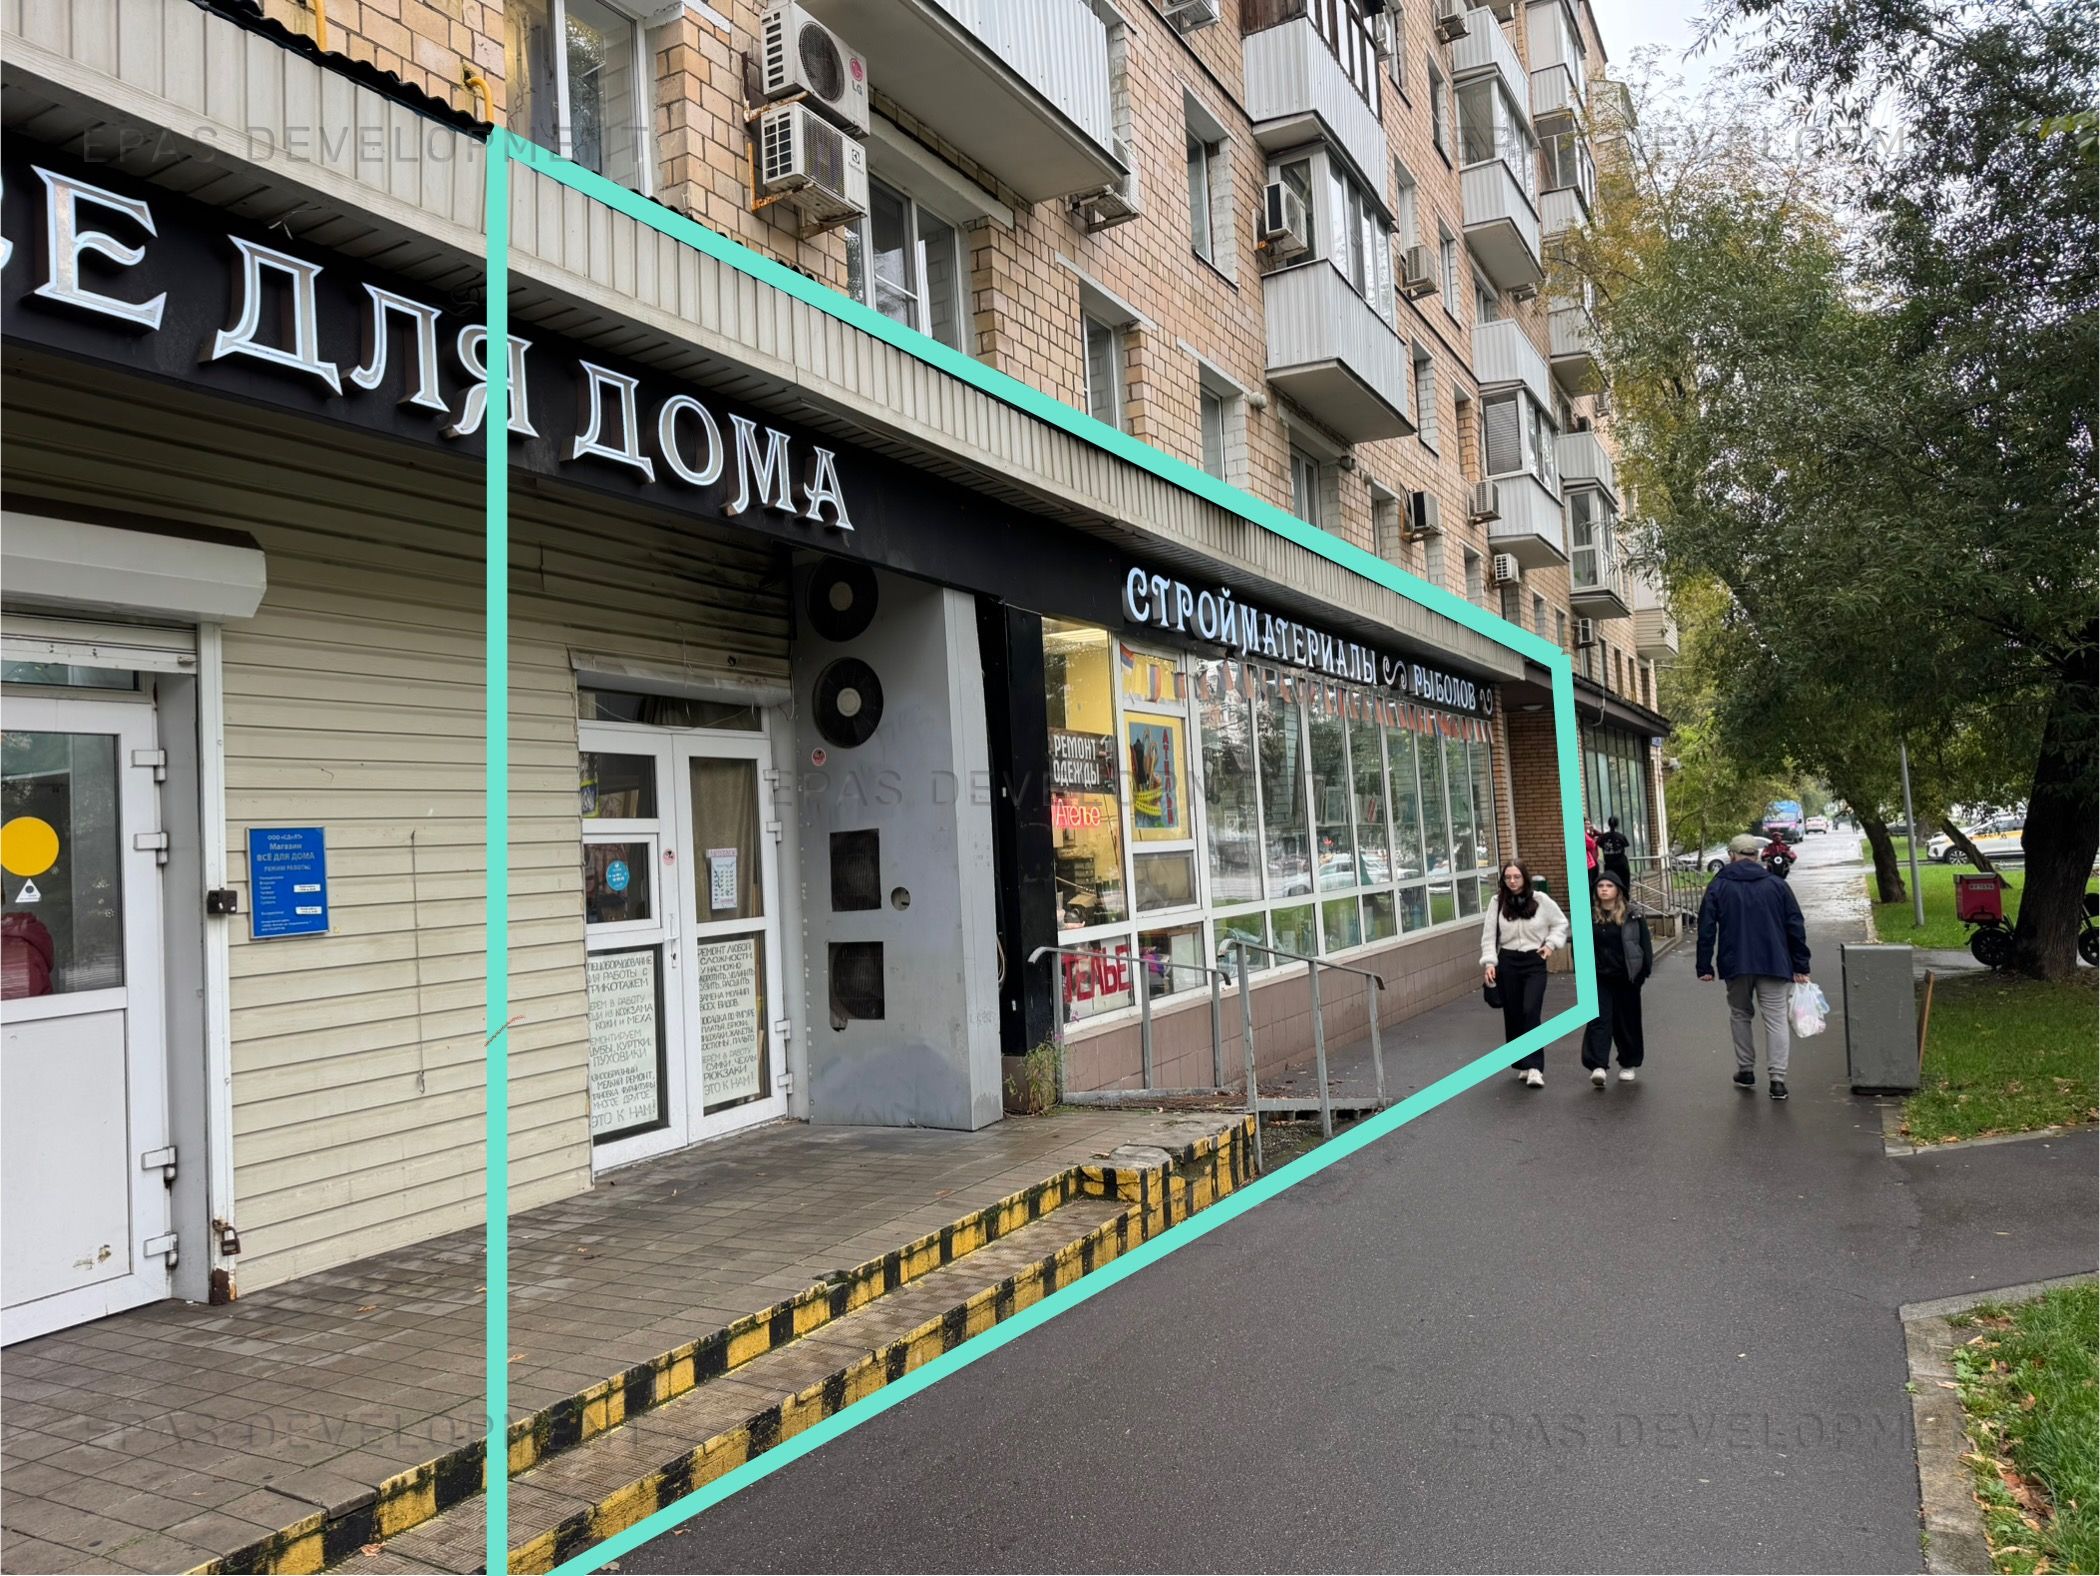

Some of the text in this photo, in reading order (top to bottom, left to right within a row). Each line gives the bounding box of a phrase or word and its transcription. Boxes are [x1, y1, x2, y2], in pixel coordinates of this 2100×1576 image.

[1, 170, 855, 531] Е ДЛЯ ДОМА
[1126, 566, 1476, 711] СТРОЙМАТЕРИАЛЫ РЫБОЛОВ
[1053, 734, 1096, 761] РЕМОНТ
[1053, 759, 1100, 788] ОДЕЖДЫ
[1055, 798, 1101, 827] Ателье
[269, 843, 302, 851] Магазин
[291, 852, 315, 861] ДОМА
[697, 945, 725, 957] РЕМОНТ
[603, 968, 636, 981] РАБОТЫ
[627, 1012, 651, 1024] МЕХА
[593, 1047, 646, 1066] ПУХОВИКИ
[703, 1064, 746, 1081] РЮКЗАКИ
[704, 1070, 753, 1095] ЭТО К НАМ!
[591, 1098, 655, 1128] ЭТО К НАМ!
